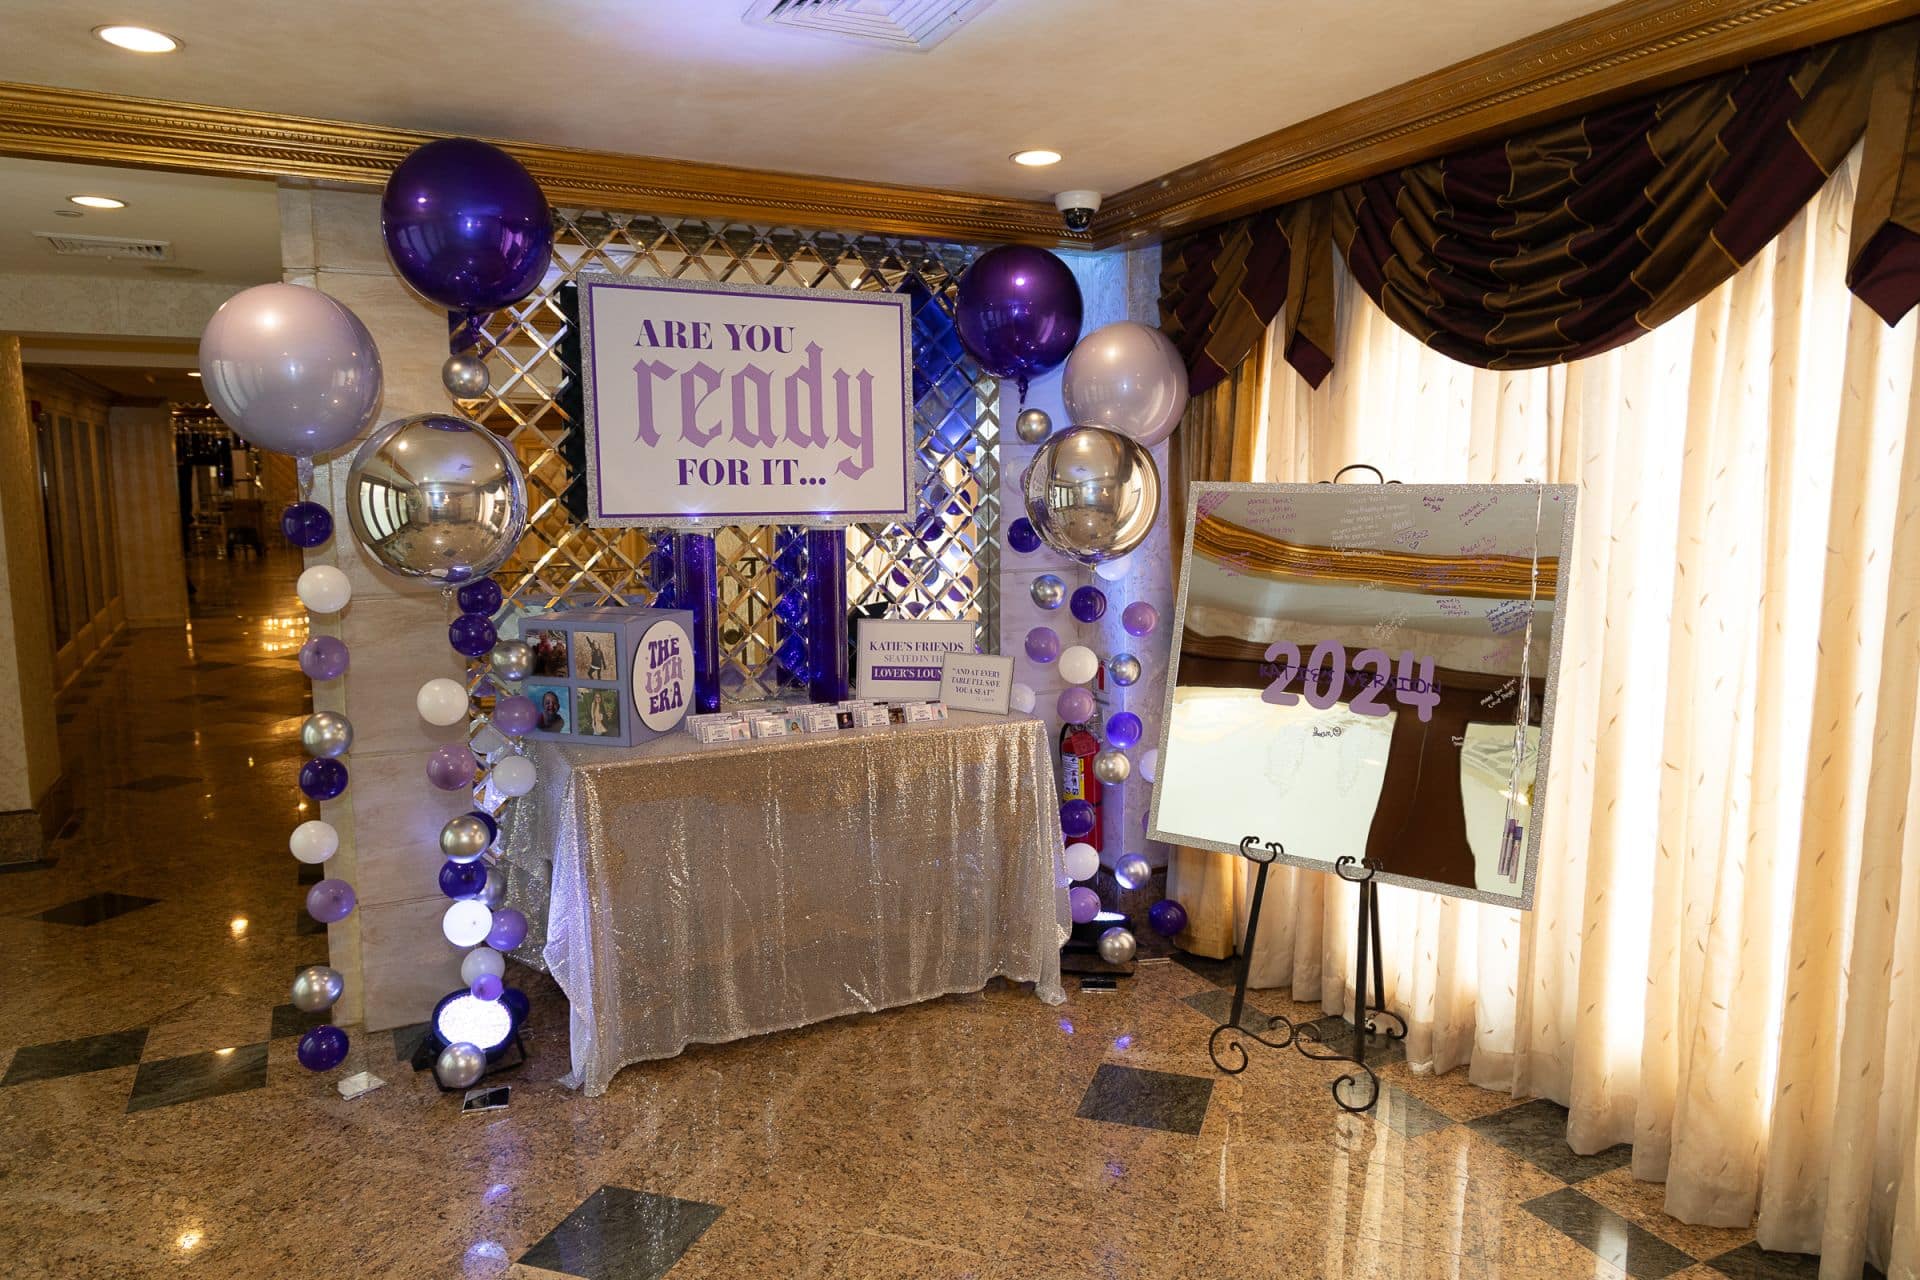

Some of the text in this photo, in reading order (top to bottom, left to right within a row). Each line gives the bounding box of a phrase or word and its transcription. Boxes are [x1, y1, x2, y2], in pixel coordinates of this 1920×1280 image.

[634, 319, 795, 354] ARE YOU
[632, 339, 875, 481] ready
[675, 458, 827, 486] FOR IT...
[647, 637, 680, 669] THE
[869, 641, 964, 652] KATIE'S FRIENDS
[883, 654, 918, 664] SEATED
[918, 655, 928, 664] IN
[644, 656, 684, 694] 13TH
[873, 667, 915, 678] LOVER'S
[951, 677, 970, 686] TABLE
[985, 680, 1001, 688] SAVE
[970, 669, 979, 677] AT
[980, 670, 1001, 679] EVERY
[1260, 639, 1441, 723] 2024
[648, 681, 684, 715] ERA
[955, 685, 968, 694] YOU
